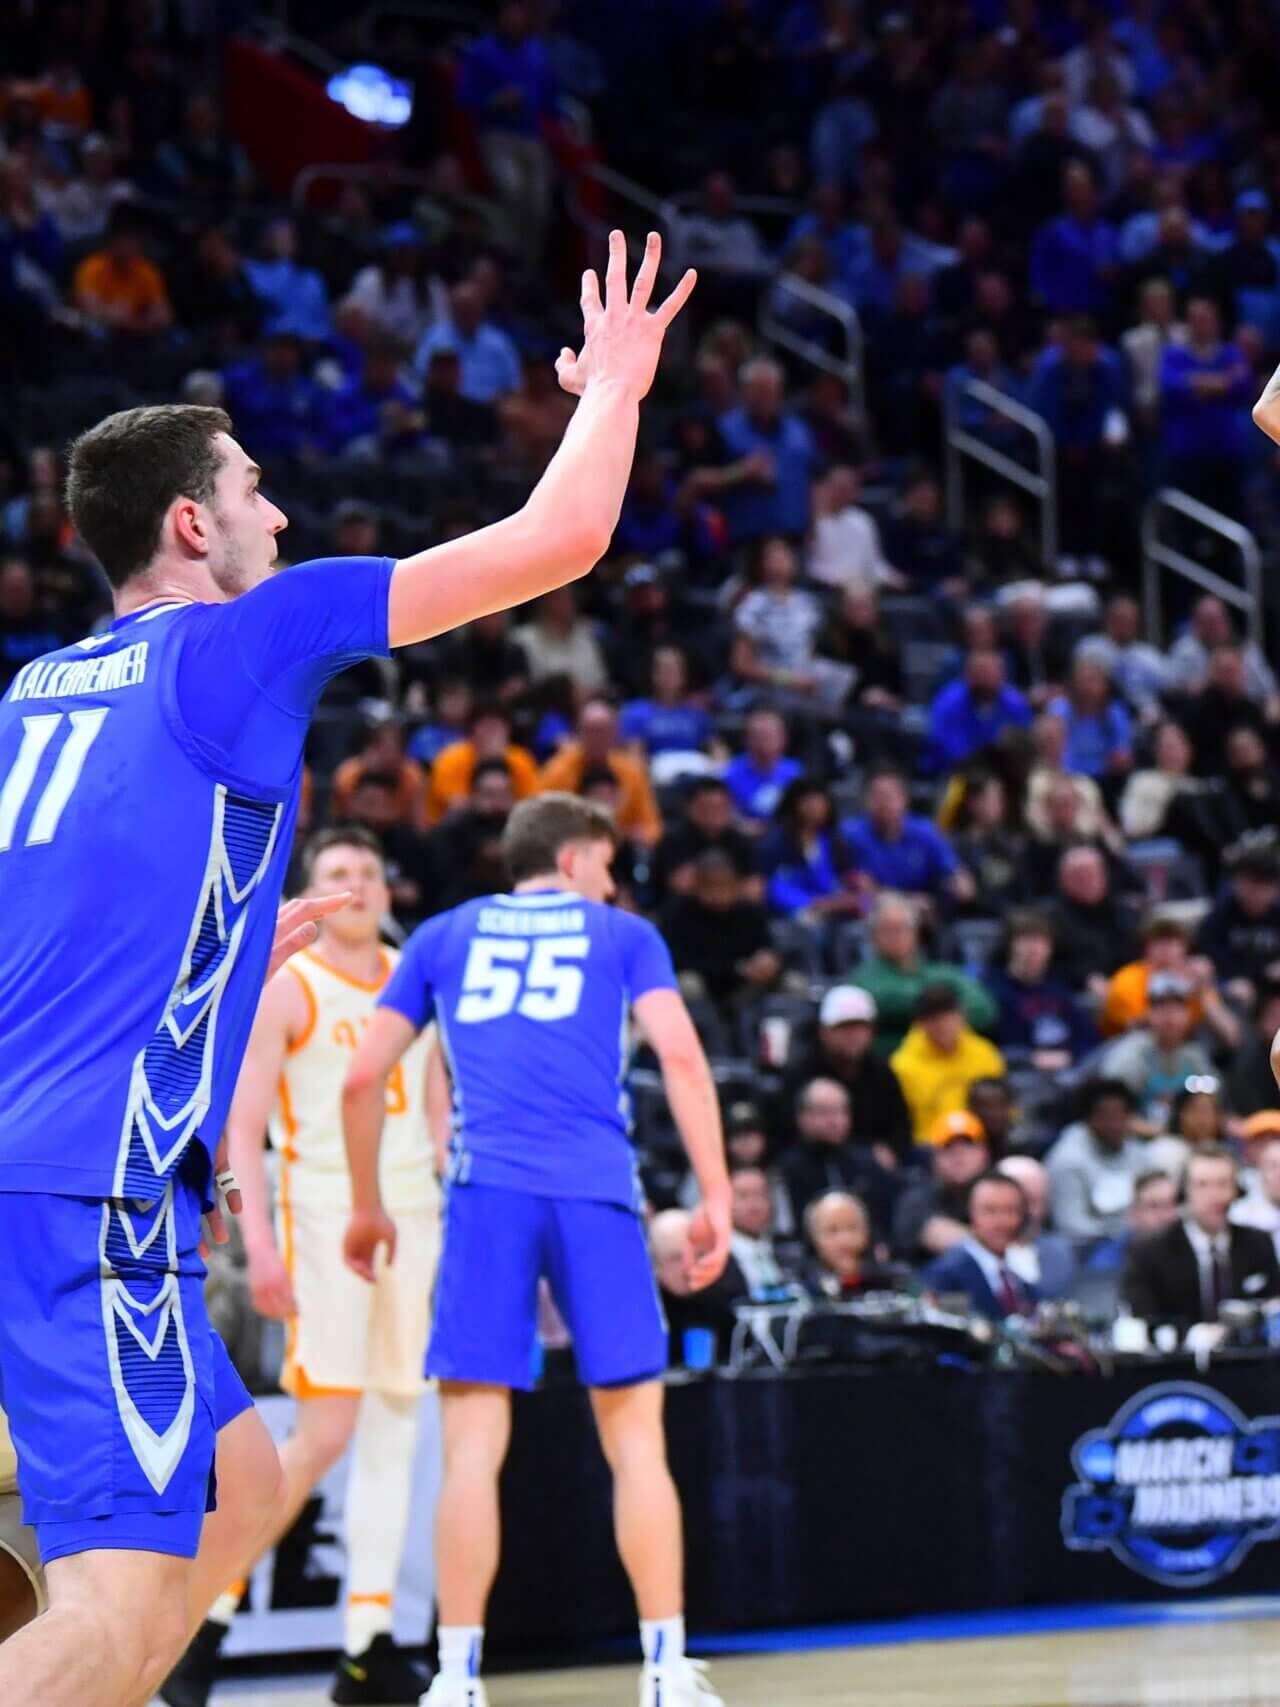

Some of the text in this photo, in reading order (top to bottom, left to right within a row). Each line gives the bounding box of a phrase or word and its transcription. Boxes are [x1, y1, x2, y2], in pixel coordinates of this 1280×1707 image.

[0, 707, 110, 850] 11
[455, 936, 591, 1023] 55
[1115, 1438, 1234, 1484] MARCH
